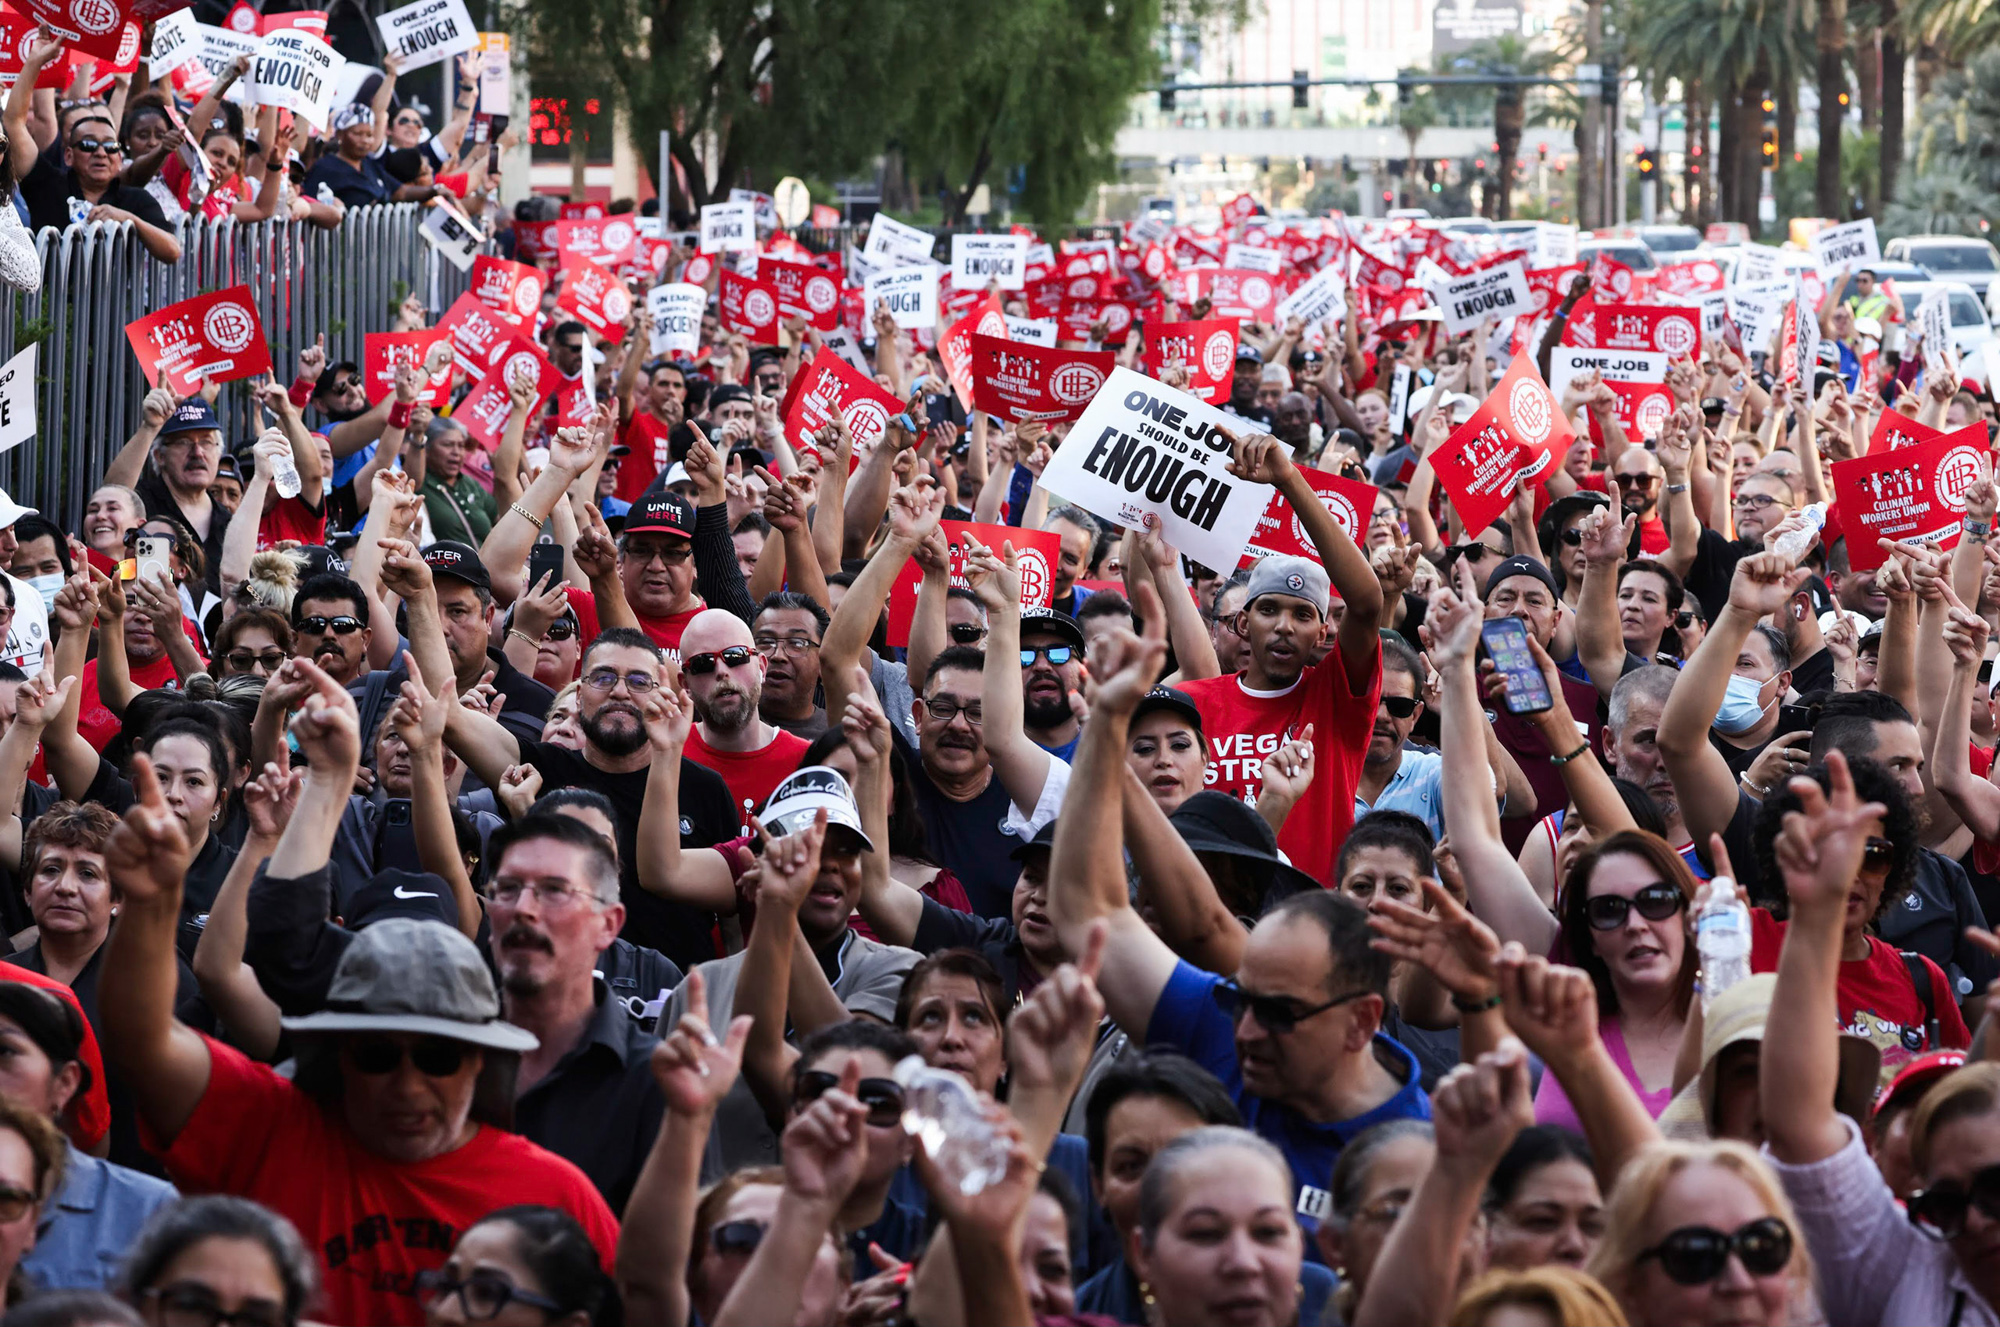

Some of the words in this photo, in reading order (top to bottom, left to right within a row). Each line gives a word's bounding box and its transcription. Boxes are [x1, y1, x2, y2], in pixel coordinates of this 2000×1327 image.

[392, 11, 418, 27] ONE
[420, 1, 448, 17] JOB
[150, 25, 186, 63] CIENTE
[399, 18, 458, 56] ENOUGH
[266, 37, 303, 51] ONE
[304, 46, 331, 68] JOB
[255, 57, 323, 105] ENOUGH
[965, 257, 1014, 275] ENOUGH
[873, 277, 893, 288] ONE
[896, 274, 923, 283] JOB
[1449, 281, 1478, 294] ONE
[1481, 271, 1509, 286] JOB
[873, 292, 921, 313] EUGH
[1454, 287, 1516, 320] ENOUGH
[1012, 326, 1042, 337] JOB
[1571, 357, 1609, 369] ONE
[1612, 360, 1650, 371] JOB
[985, 376, 1018, 393] WORKERS
[1018, 384, 1042, 397] UNION
[996, 372, 1030, 387] CULINARY
[1124, 390, 1188, 431] ONE
[1183, 422, 1236, 459] JO
[1137, 422, 1189, 454] SHOULD
[1190, 448, 1211, 466] BE
[1465, 465, 1499, 496] WORKERS
[1498, 445, 1520, 468] UNION
[1473, 447, 1505, 478] CULINARY
[1082, 426, 1233, 532] ENOUGH
[647, 502, 682, 515] UNITE
[1860, 508, 1902, 525] WORKERS
[1902, 501, 1931, 516] UNION
[1872, 495, 1914, 512] CULINARY
[645, 511, 682, 525] HERE!
[1260, 515, 1282, 529] NION
[1868, 518, 1904, 530] LOCAL
[1909, 514, 1926, 522] 226
[424, 550, 461, 562] ALTER
[1212, 732, 1292, 757] VEGA
[1203, 758, 1263, 785] STR
